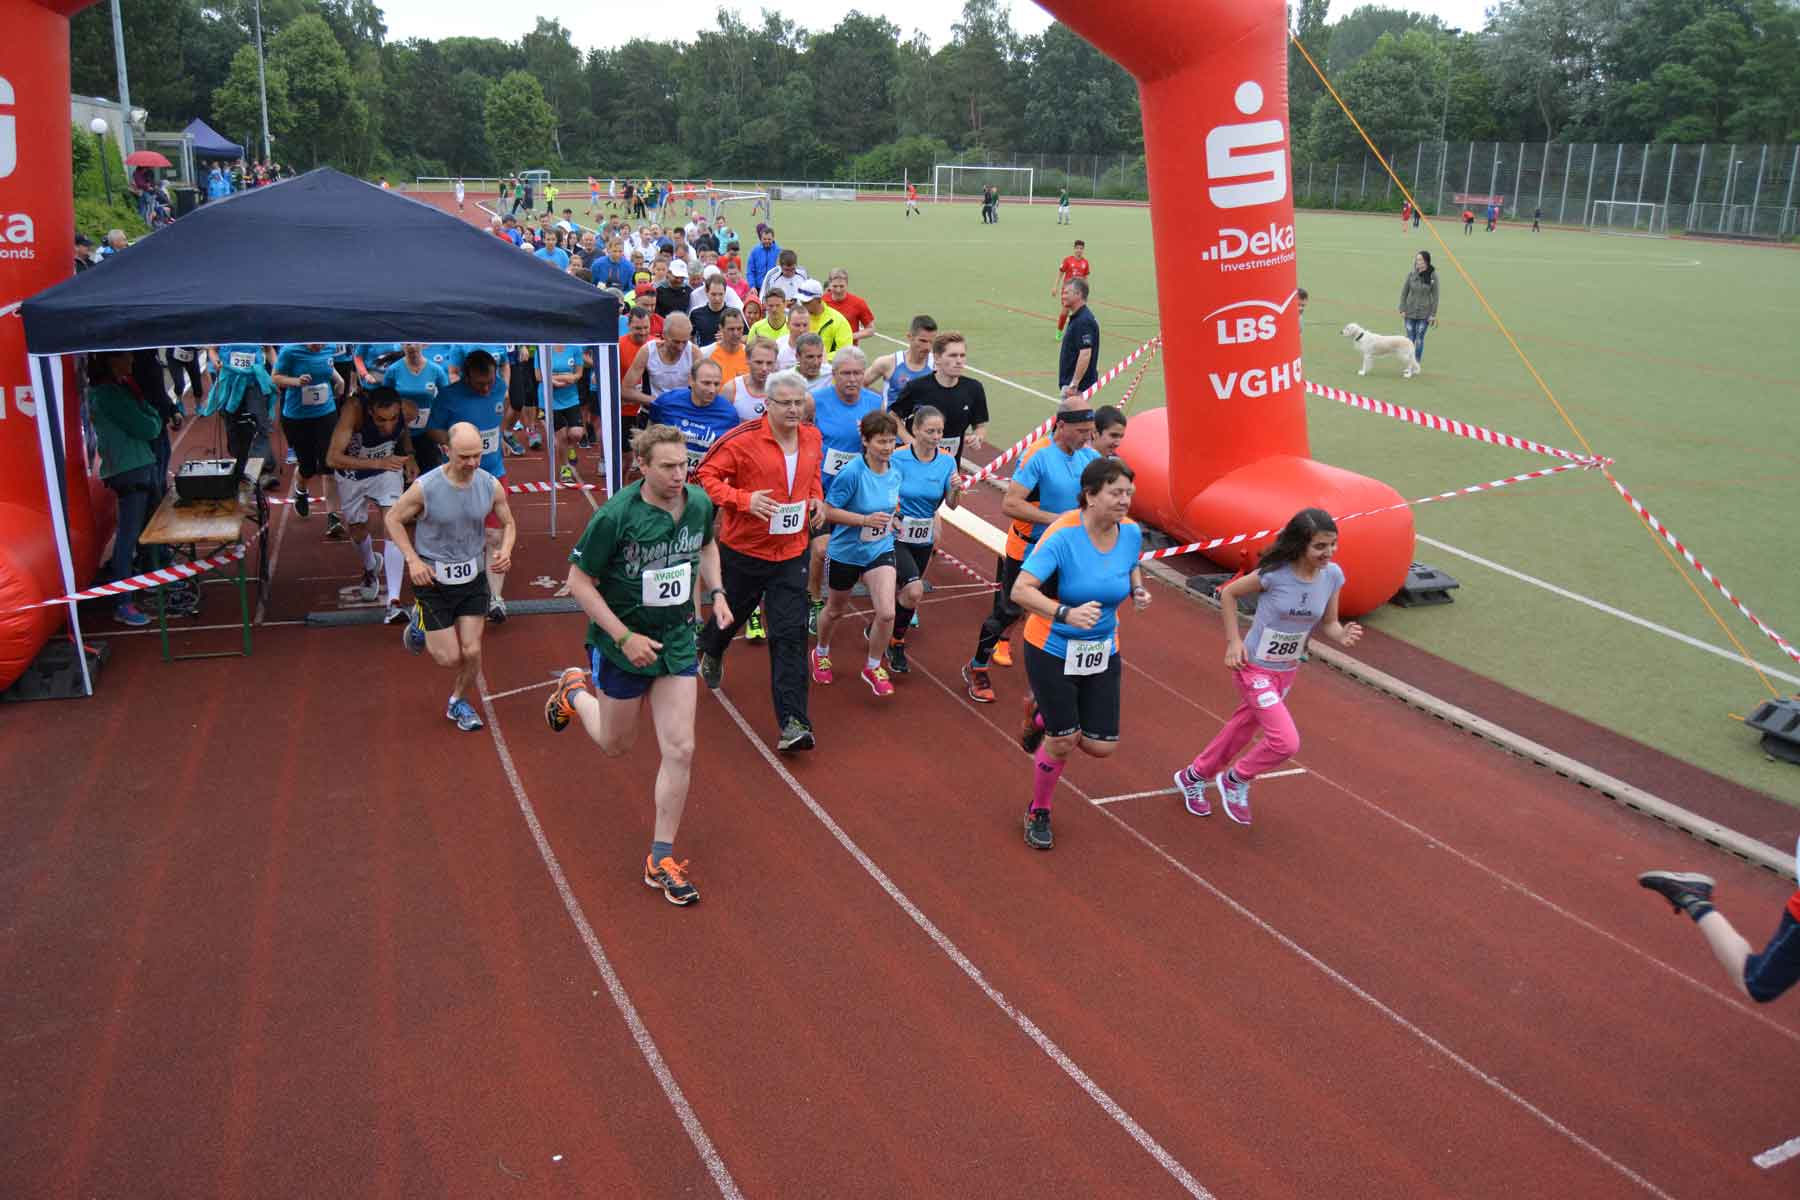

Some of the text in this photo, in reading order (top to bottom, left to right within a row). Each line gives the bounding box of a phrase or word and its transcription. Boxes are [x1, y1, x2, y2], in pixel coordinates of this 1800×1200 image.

[1218, 223, 1295, 259] Deka
[1220, 252, 1295, 272] Investmentfond
[1217, 315, 1277, 344] LBS
[1208, 363, 1291, 400] VGH
[783, 513, 799, 528] 50
[908, 526, 929, 539] 108
[444, 563, 471, 579] 130
[659, 580, 681, 599] 20
[1267, 640, 1299, 655] 288
[1075, 651, 1103, 668] 109
